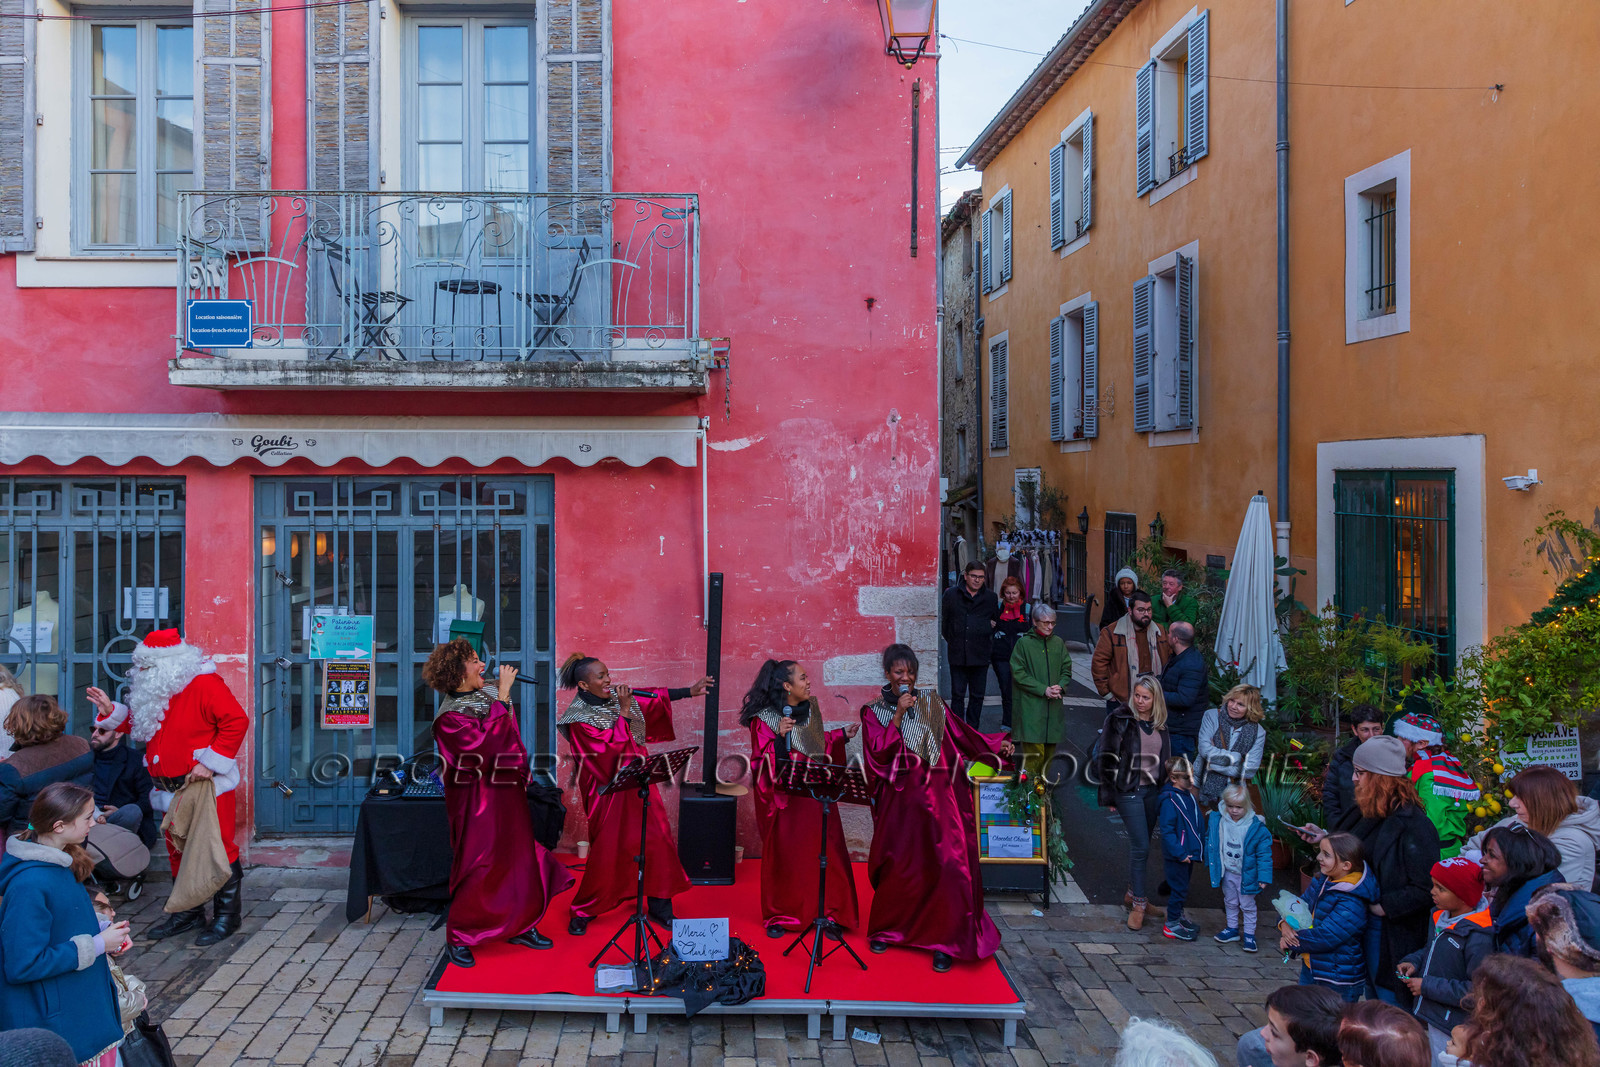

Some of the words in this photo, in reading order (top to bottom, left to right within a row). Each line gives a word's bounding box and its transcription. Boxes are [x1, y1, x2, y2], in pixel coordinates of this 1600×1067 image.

[251, 434, 297, 453] Goubi
[1531, 739, 1578, 749] PEPINIERES
[1568, 770, 1579, 778] 23
[991, 834, 1013, 842] Chocolat
[677, 924, 706, 938] Merci
[677, 940, 707, 957] Thank
[706, 948, 723, 959] you
